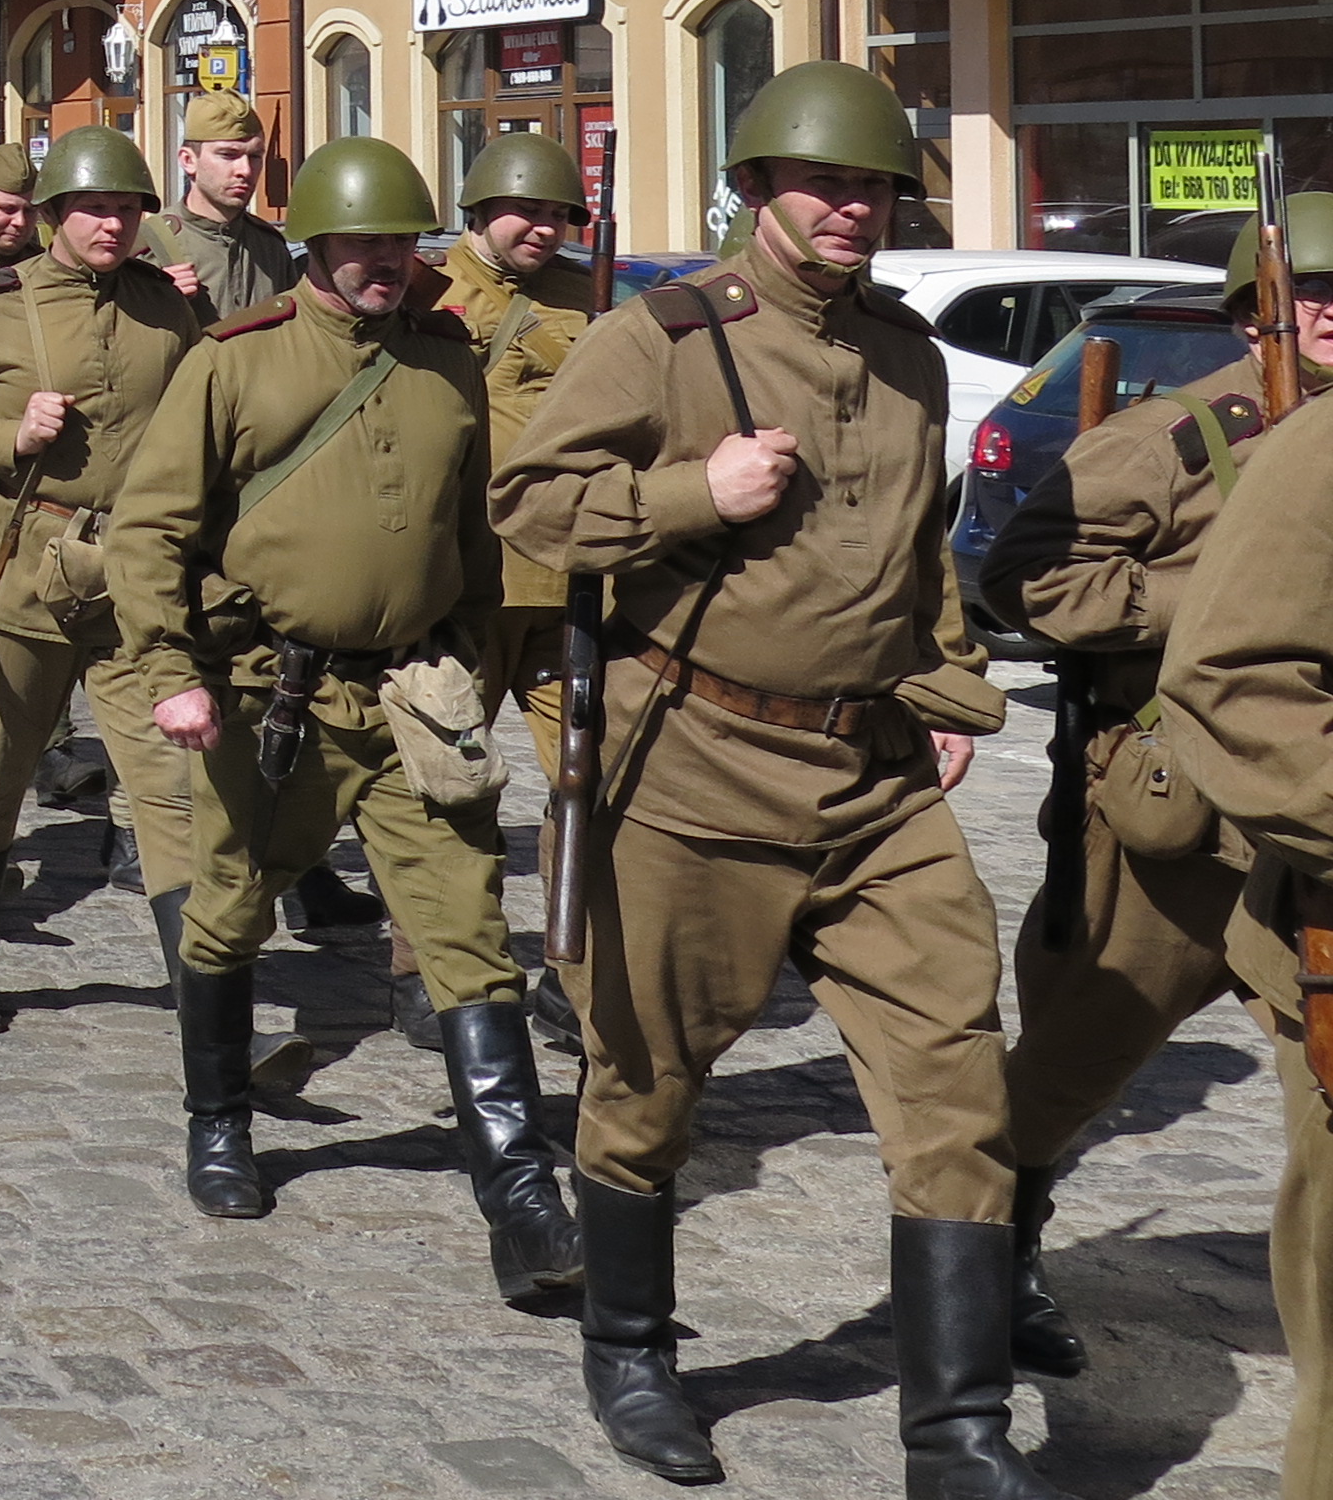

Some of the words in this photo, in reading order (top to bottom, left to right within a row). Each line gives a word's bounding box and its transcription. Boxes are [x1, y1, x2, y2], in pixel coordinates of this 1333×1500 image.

[213, 60, 222, 74] P
[1154, 141, 1171, 167] DO
[1183, 175, 1204, 200] 668
[1207, 174, 1229, 200] 760
